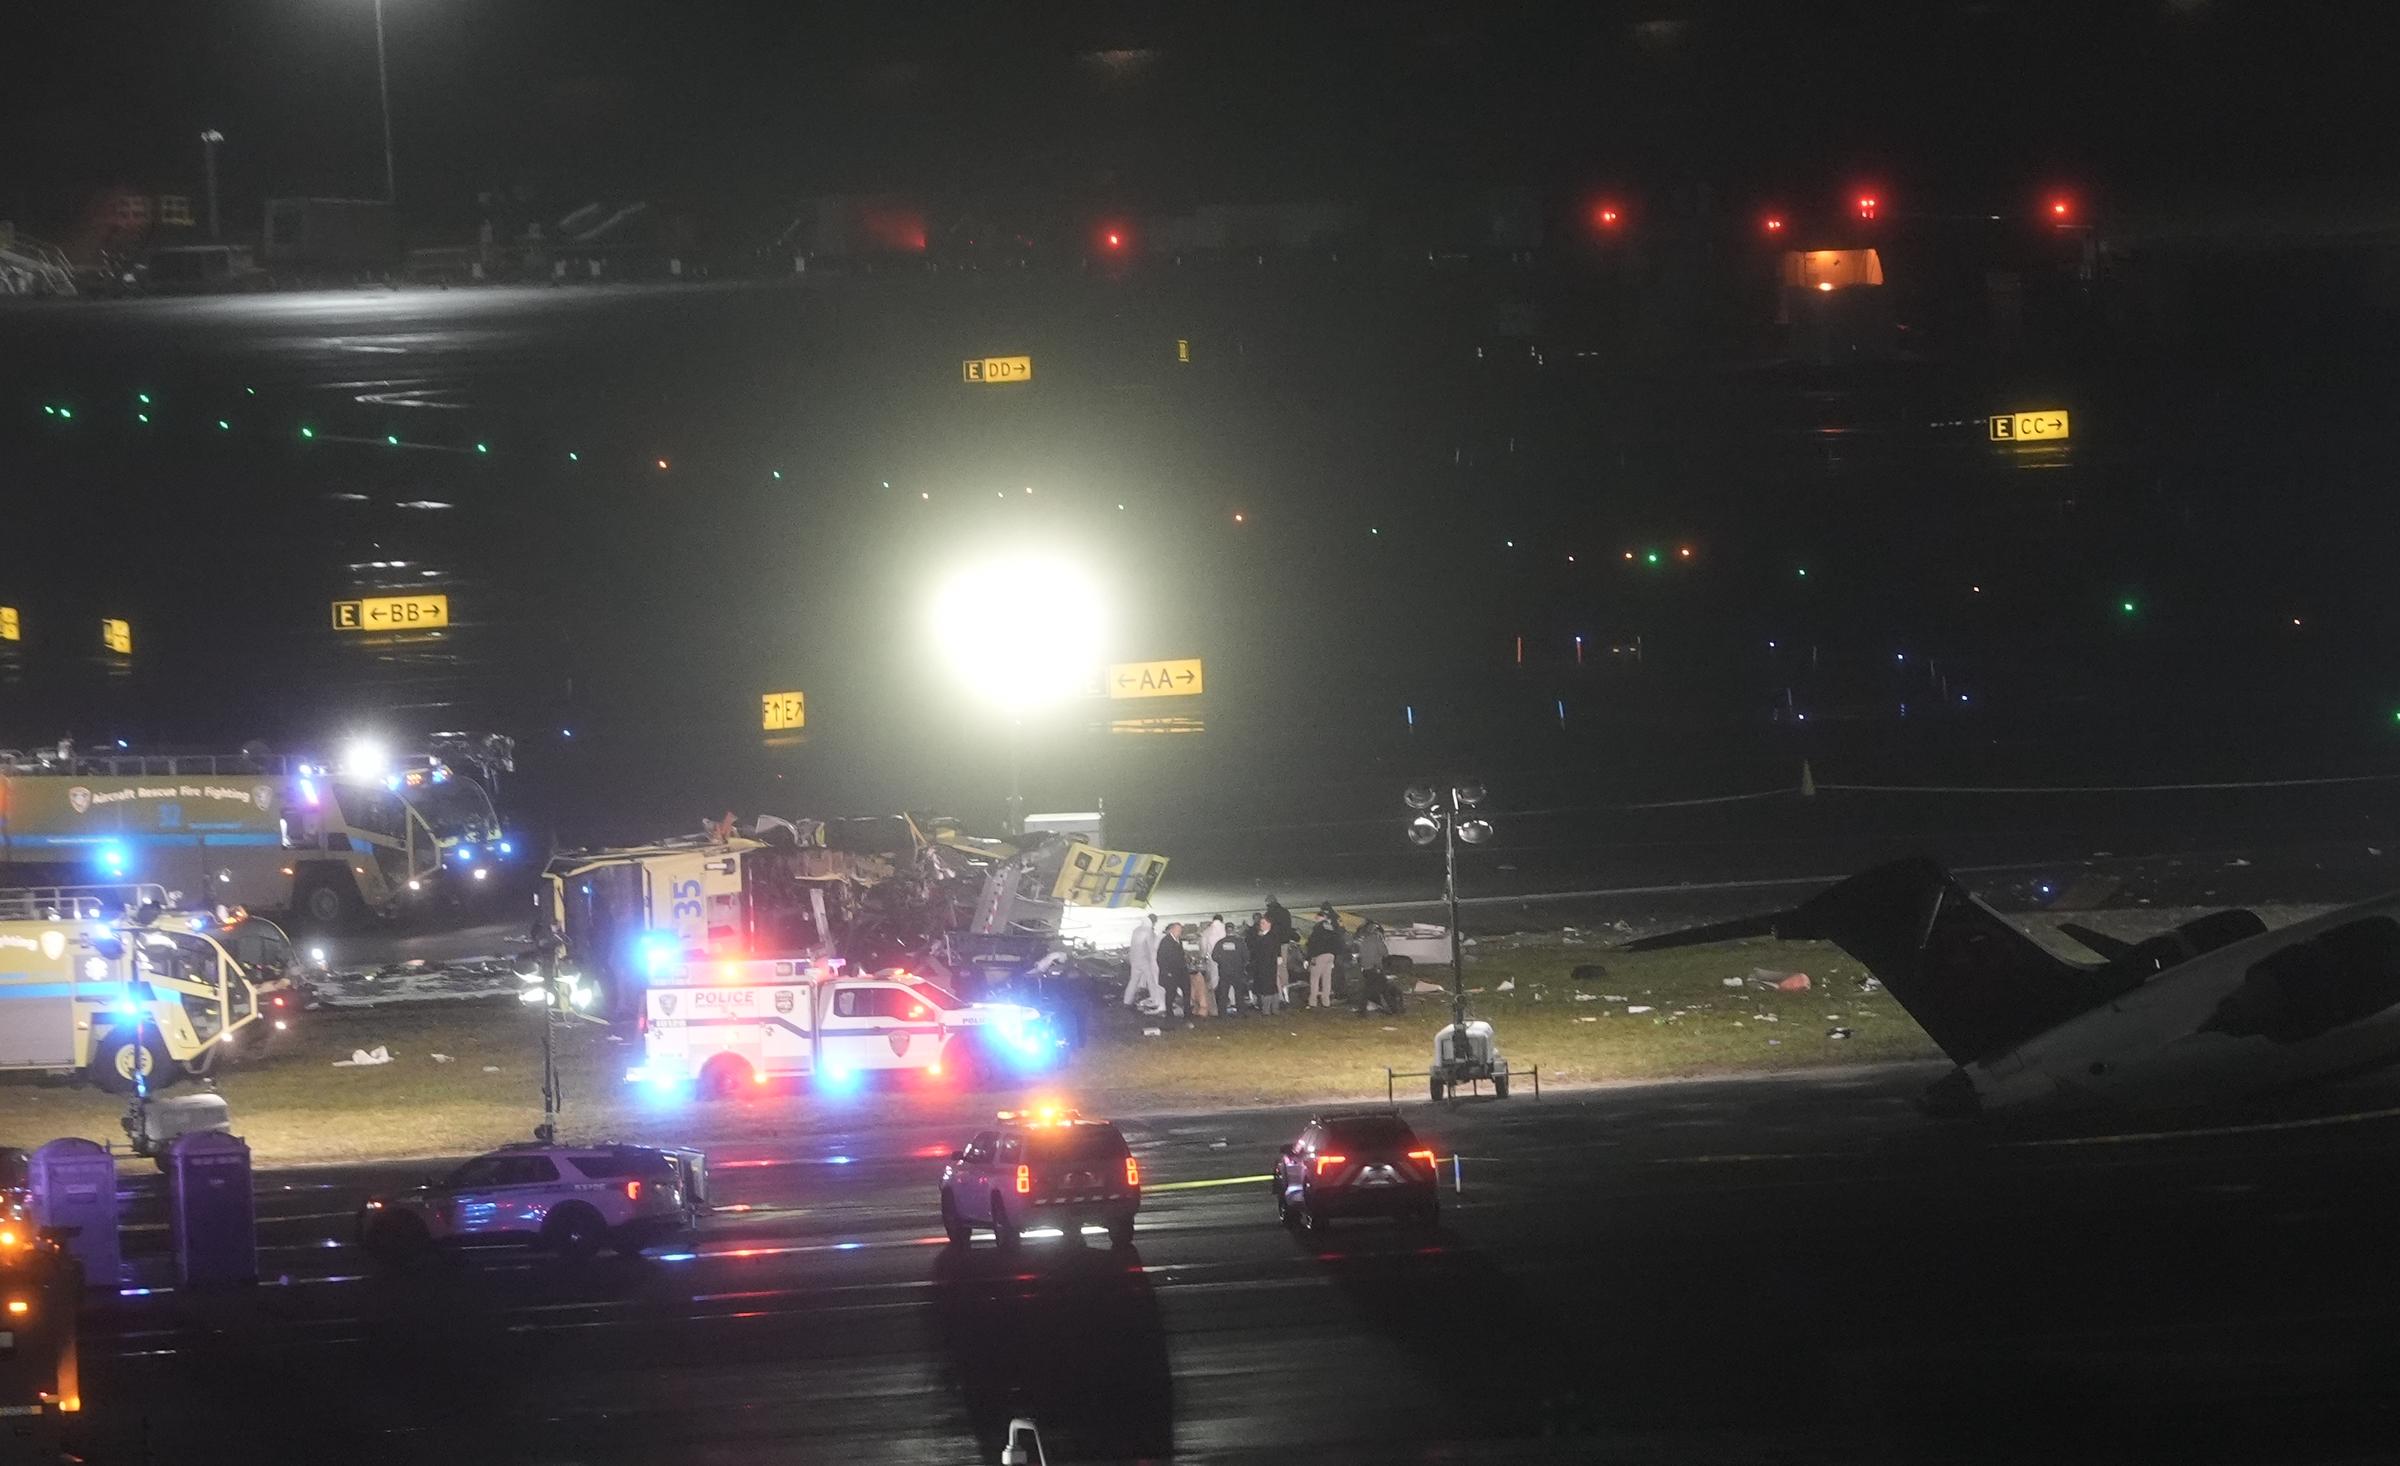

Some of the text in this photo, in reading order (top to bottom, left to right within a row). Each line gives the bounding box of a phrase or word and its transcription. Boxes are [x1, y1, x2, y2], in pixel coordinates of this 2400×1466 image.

[969, 362, 1010, 379] E DD
[1996, 417, 2044, 437] E CC
[340, 603, 419, 626] E BB
[1140, 668, 1173, 690] AA
[786, 700, 793, 720] E
[92, 785, 250, 804] Aircraft Rescue Fire Fighting
[673, 880, 702, 919] 35
[695, 991, 753, 1004] POLICE
